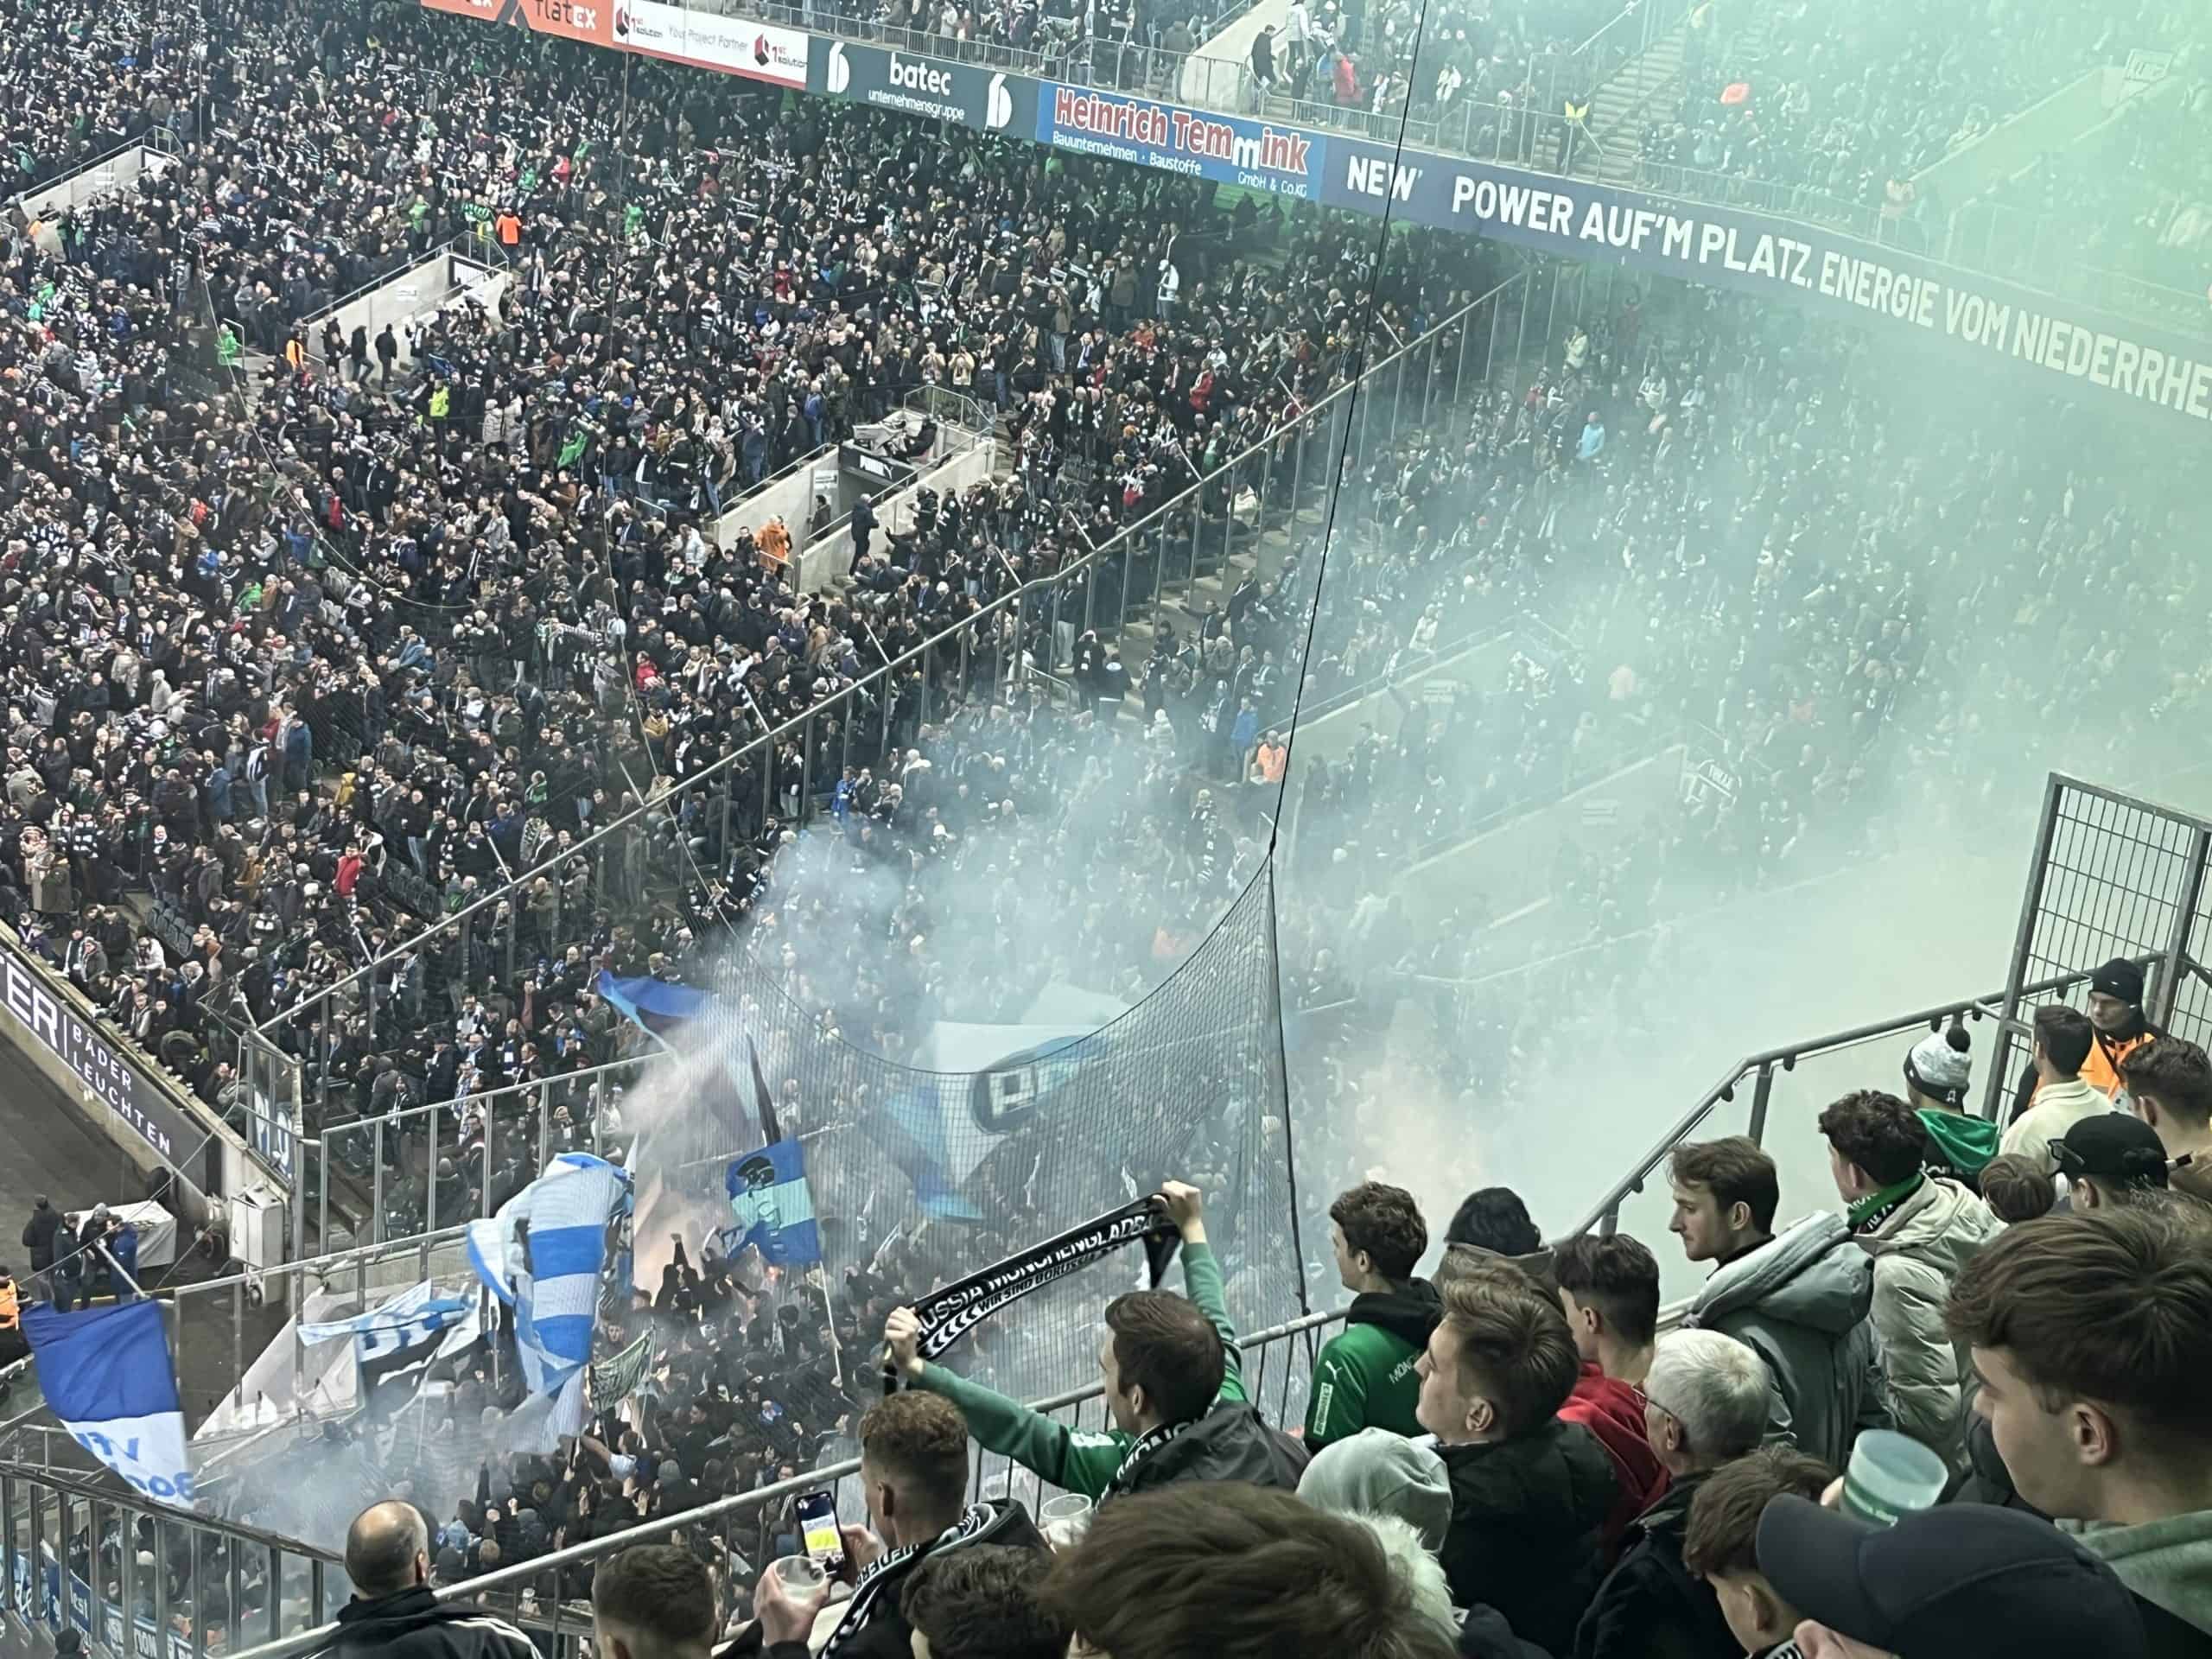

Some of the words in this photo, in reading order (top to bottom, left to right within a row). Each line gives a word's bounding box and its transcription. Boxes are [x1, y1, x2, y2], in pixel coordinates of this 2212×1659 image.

[868, 89, 965, 121] unternehmensgruppe
[889, 52, 952, 96] batec
[1052, 130, 1138, 162] Bauunternehmen
[1149, 150, 1203, 175] Baustoffe
[1054, 87, 1168, 147] Heinrich
[1172, 111, 1312, 175] Temmink
[1237, 172, 1267, 188] GmbH
[1452, 175, 1574, 236] POWER
[1579, 200, 1694, 264] AUF'M
[1698, 223, 1813, 289] PLATZ.
[1818, 250, 1941, 328] ENERGIE
[1945, 287, 2012, 352] VOM
[2011, 309, 2212, 421] NIEDERRHE
[0, 956, 59, 1050] ER
[73, 1050, 171, 1156] LEUCHTEN
